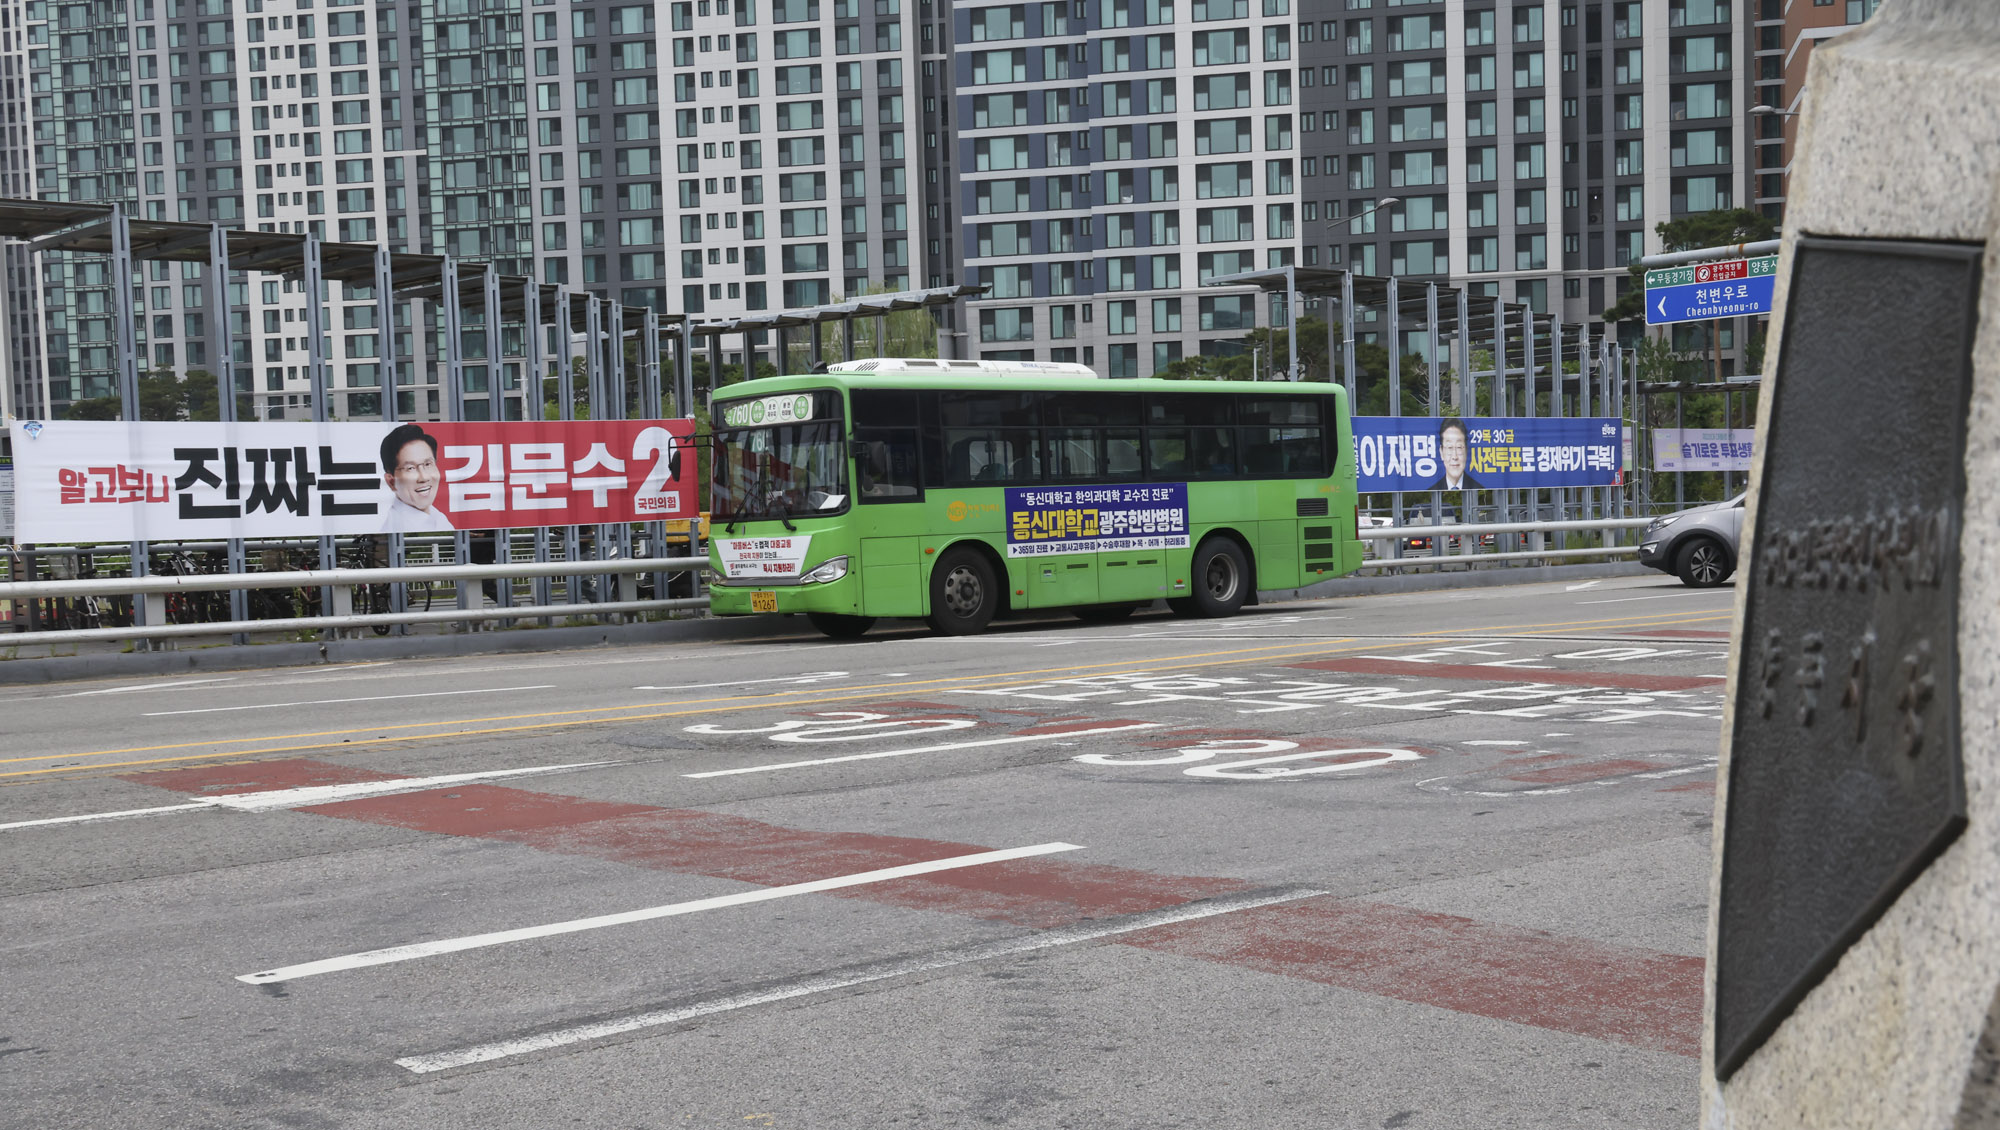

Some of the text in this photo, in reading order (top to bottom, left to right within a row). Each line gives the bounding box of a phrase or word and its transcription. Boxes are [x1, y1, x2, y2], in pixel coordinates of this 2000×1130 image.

[1712, 262, 1742, 273] 광주역방향
[1657, 270, 1693, 284] 무등경기장
[1712, 271, 1736, 281] 진입금지
[1696, 284, 1749, 305] 천변우로
[1686, 302, 1759, 317] Cheonbyeonu-ro
[731, 404, 748, 425] 760
[1469, 429, 1515, 444] 29목 30금
[1360, 434, 1437, 478] 이재명
[1682, 442, 1719, 458] 슬기로운
[1469, 446, 1535, 473] 사전투표로
[1537, 445, 1586, 472] 경제위기
[1587, 445, 1615, 471] 극복!
[59, 464, 170, 505] 알고보니
[174, 446, 381, 519] 진짜는
[443, 442, 628, 513] 김문수
[632, 426, 680, 515] 2
[637, 496, 677, 510] 국민의힘
[1075, 490, 1121, 504] 한의과대학
[1123, 489, 1149, 502] 교수진
[1036, 544, 1049, 554] 진료
[1352, 683, 1727, 722] 보호구
[682, 711, 978, 742] 30
[1071, 739, 1427, 779] 30
